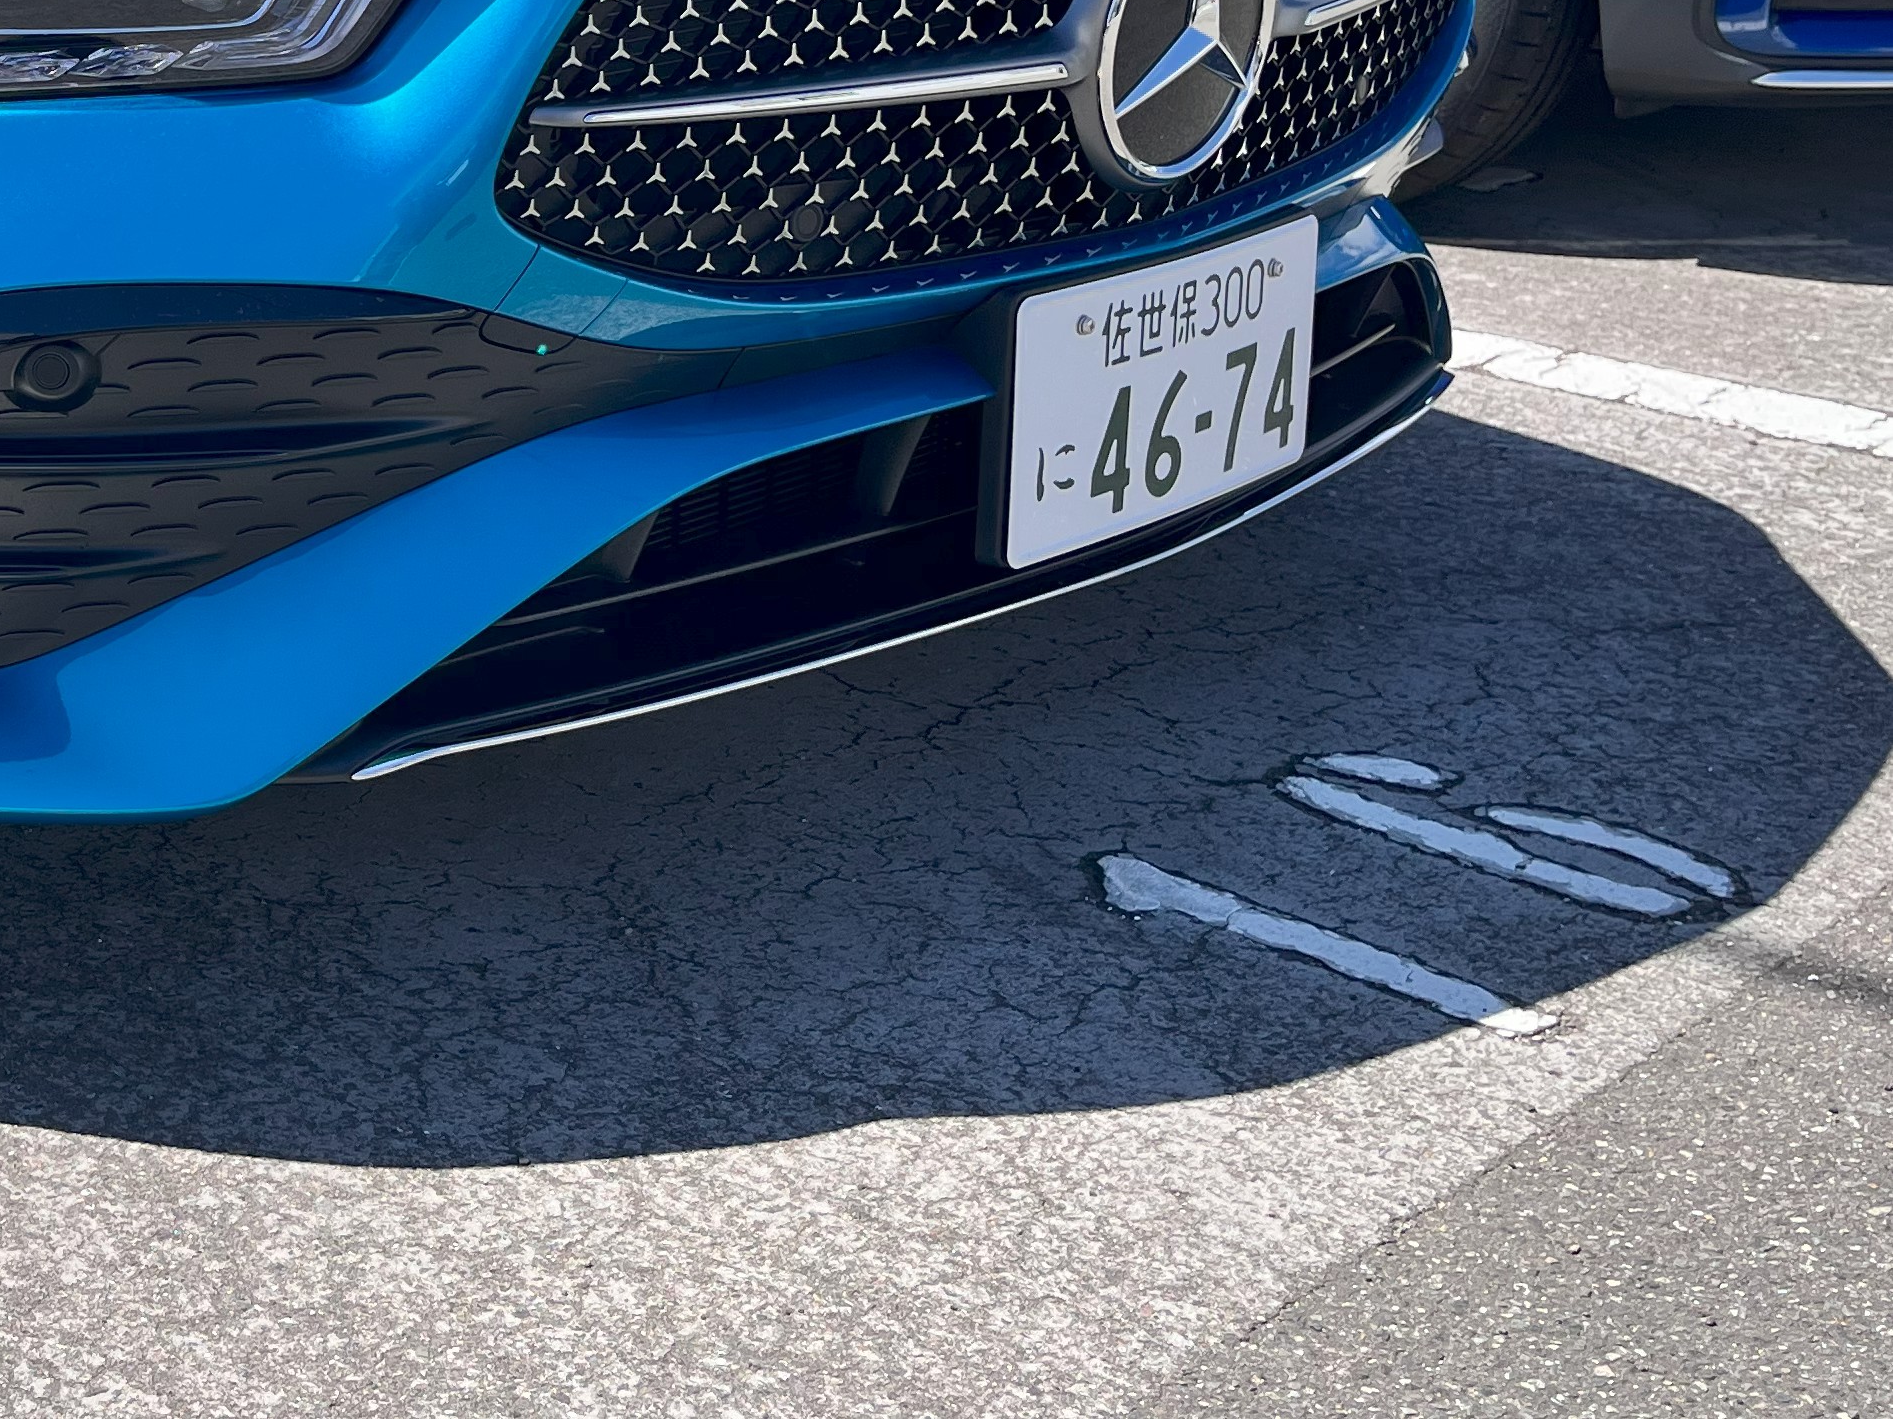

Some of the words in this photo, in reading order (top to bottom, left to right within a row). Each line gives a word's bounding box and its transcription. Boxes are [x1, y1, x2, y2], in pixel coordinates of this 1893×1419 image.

[1102, 258, 1265, 367] 佐世保300
[1036, 445, 1076, 502] に
[1090, 327, 1296, 514] 46-74
